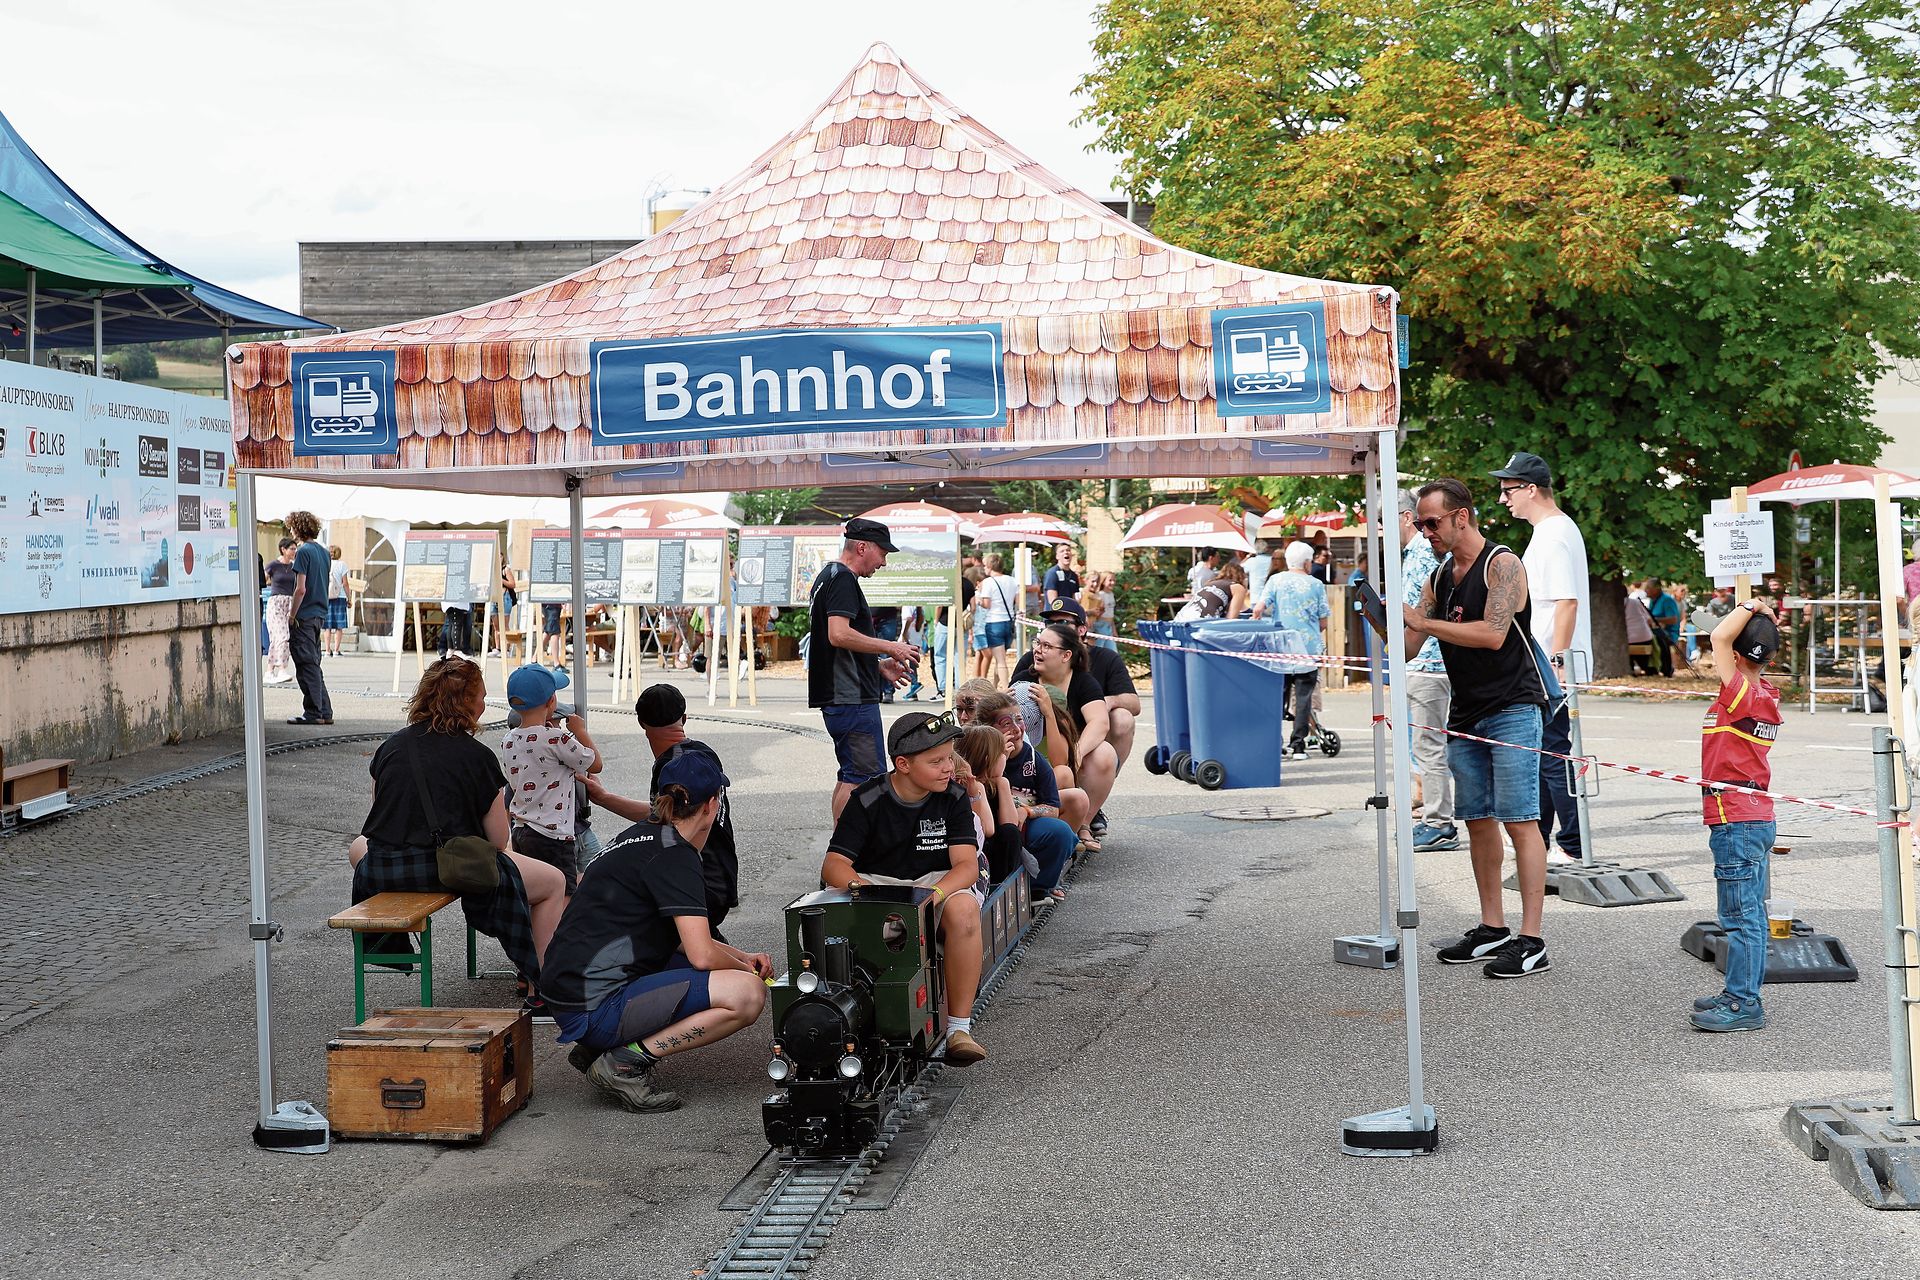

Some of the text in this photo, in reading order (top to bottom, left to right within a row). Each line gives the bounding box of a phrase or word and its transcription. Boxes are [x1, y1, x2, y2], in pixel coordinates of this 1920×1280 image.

[643, 348, 952, 422] Bahnhof
[0, 385, 74, 412] AUPTSPONSOREN
[108, 402, 170, 425] HAUPTSPONSOREN
[39, 431, 65, 456] BLKB
[84, 448, 120, 468] NOVA BYTE
[1780, 474, 1845, 490] rivella
[99, 500, 120, 520] wahl
[1163, 521, 1215, 536] rivella
[1734, 519, 1765, 527] Dampfbahn
[25, 534, 64, 549] HANDSCHIN
[1718, 552, 1763, 561] Betriebsschluss
[81, 566, 139, 578] INSIDERPOWER
[915, 843, 948, 851] Dampfbah
